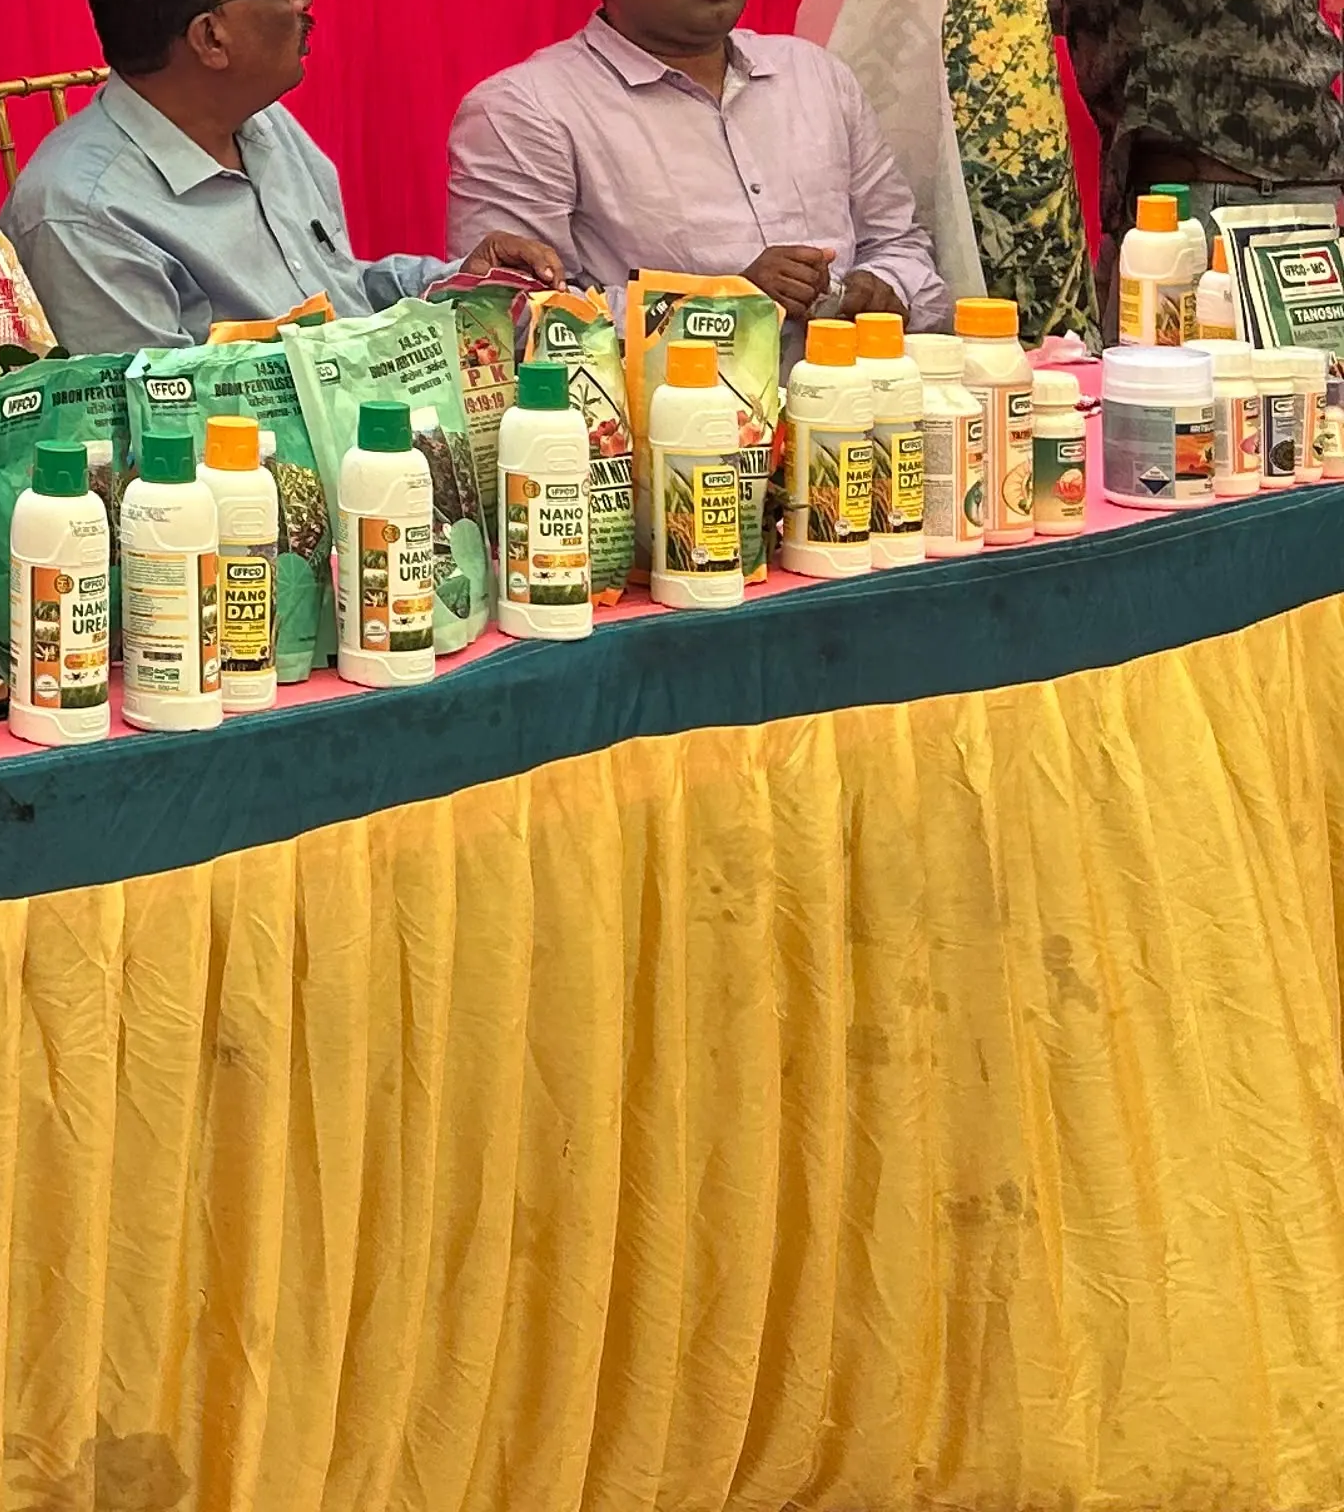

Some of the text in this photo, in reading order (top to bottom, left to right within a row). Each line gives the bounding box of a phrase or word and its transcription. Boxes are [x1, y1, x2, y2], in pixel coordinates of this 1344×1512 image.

[693, 316, 730, 332] IFFCO
[468, 364, 508, 387] P K
[150, 381, 187, 396] IFFCO
[8, 395, 37, 414] IFFCO
[702, 496, 735, 507] NANO
[540, 508, 583, 521] NANO
[704, 510, 734, 523] DAP
[540, 522, 583, 536] UREA
[226, 590, 266, 601] NANO
[228, 605, 264, 619] DAP
